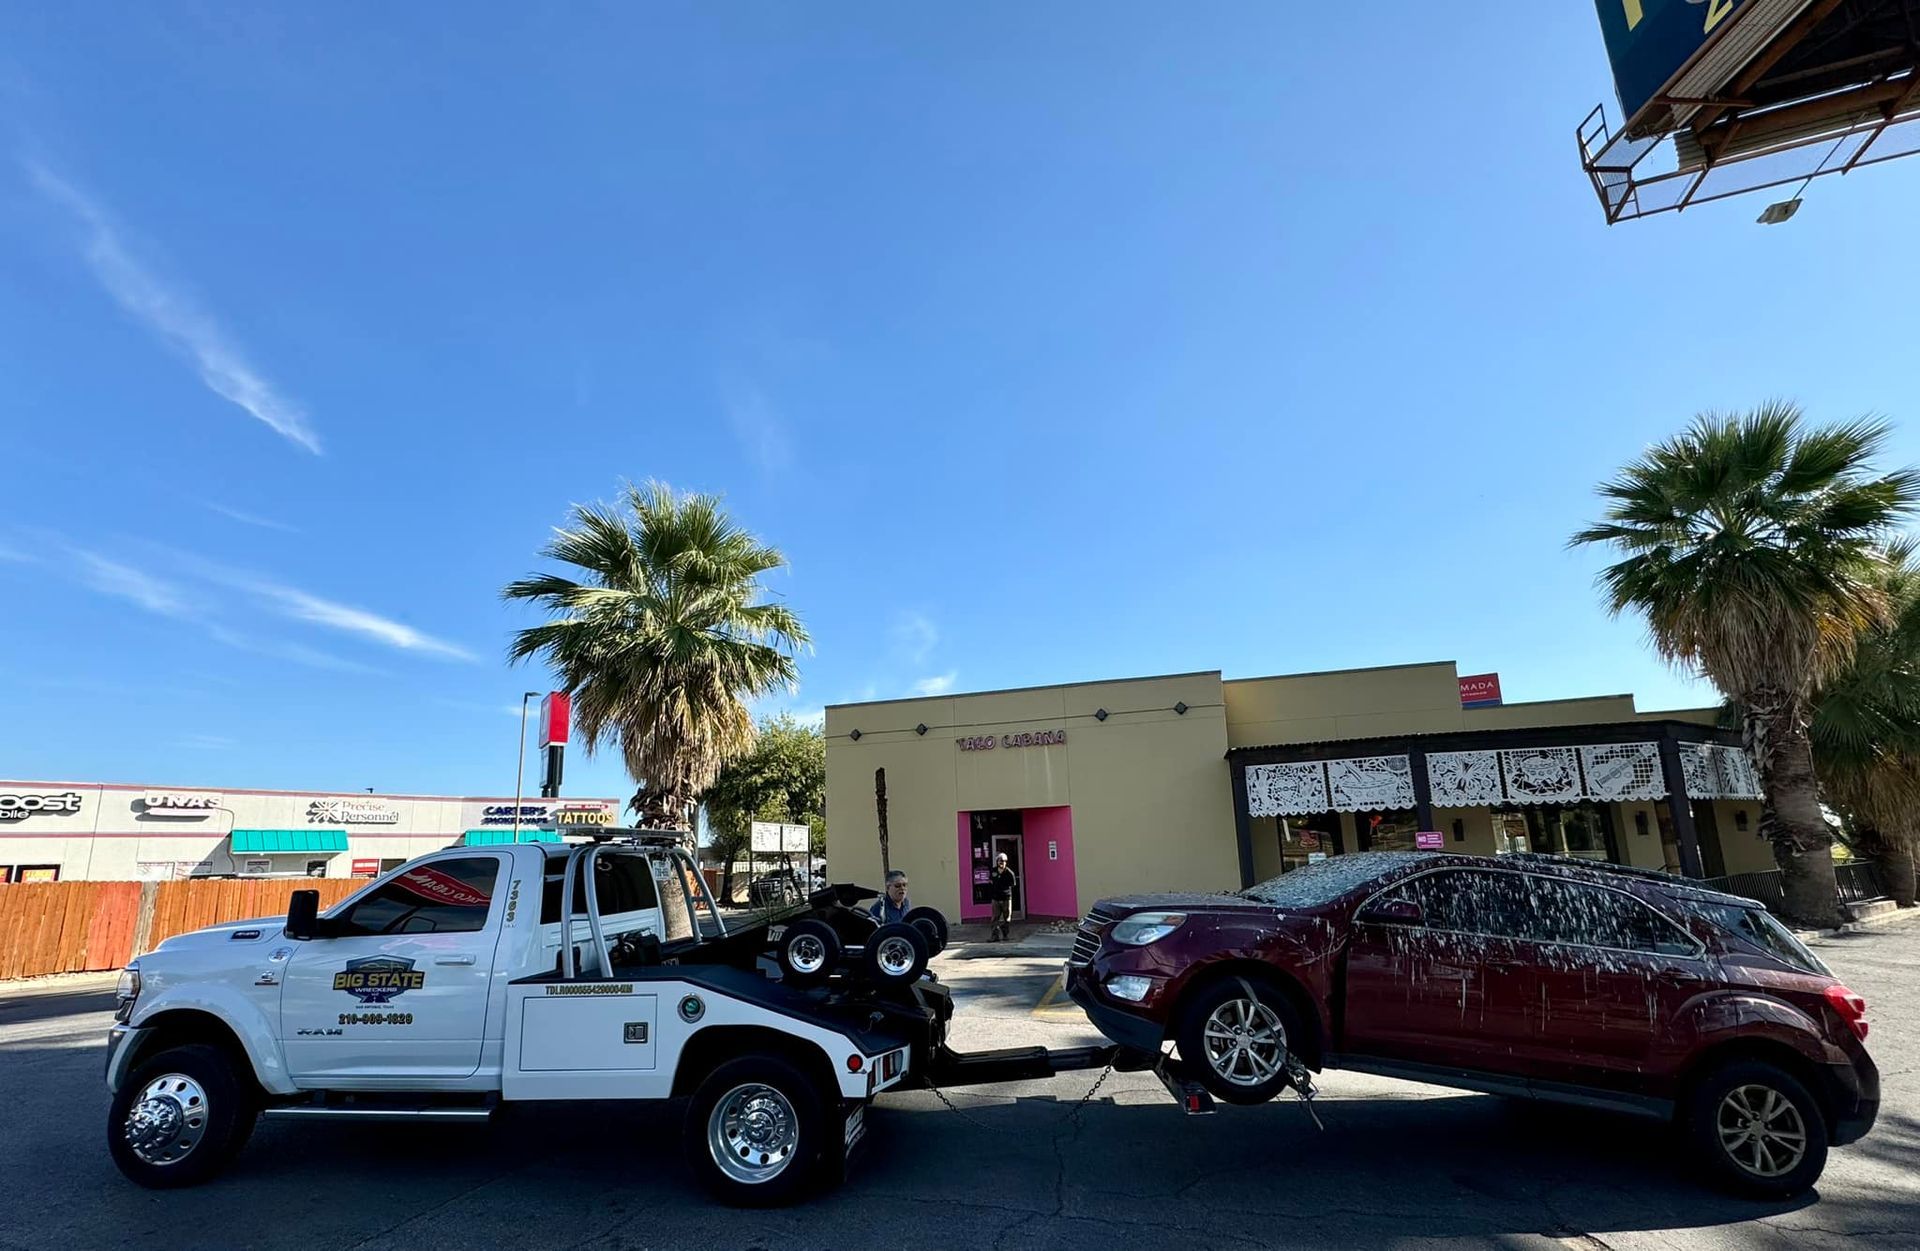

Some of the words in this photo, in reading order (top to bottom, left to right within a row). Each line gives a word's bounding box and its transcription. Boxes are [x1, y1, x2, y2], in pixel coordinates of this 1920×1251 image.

[956, 736, 996, 752] TACO
[342, 801, 385, 811] Precise
[340, 811, 400, 822] Personnel
[556, 811, 615, 825] TATTOOS
[334, 973, 364, 989] BIG
[367, 972, 424, 988] STATE
